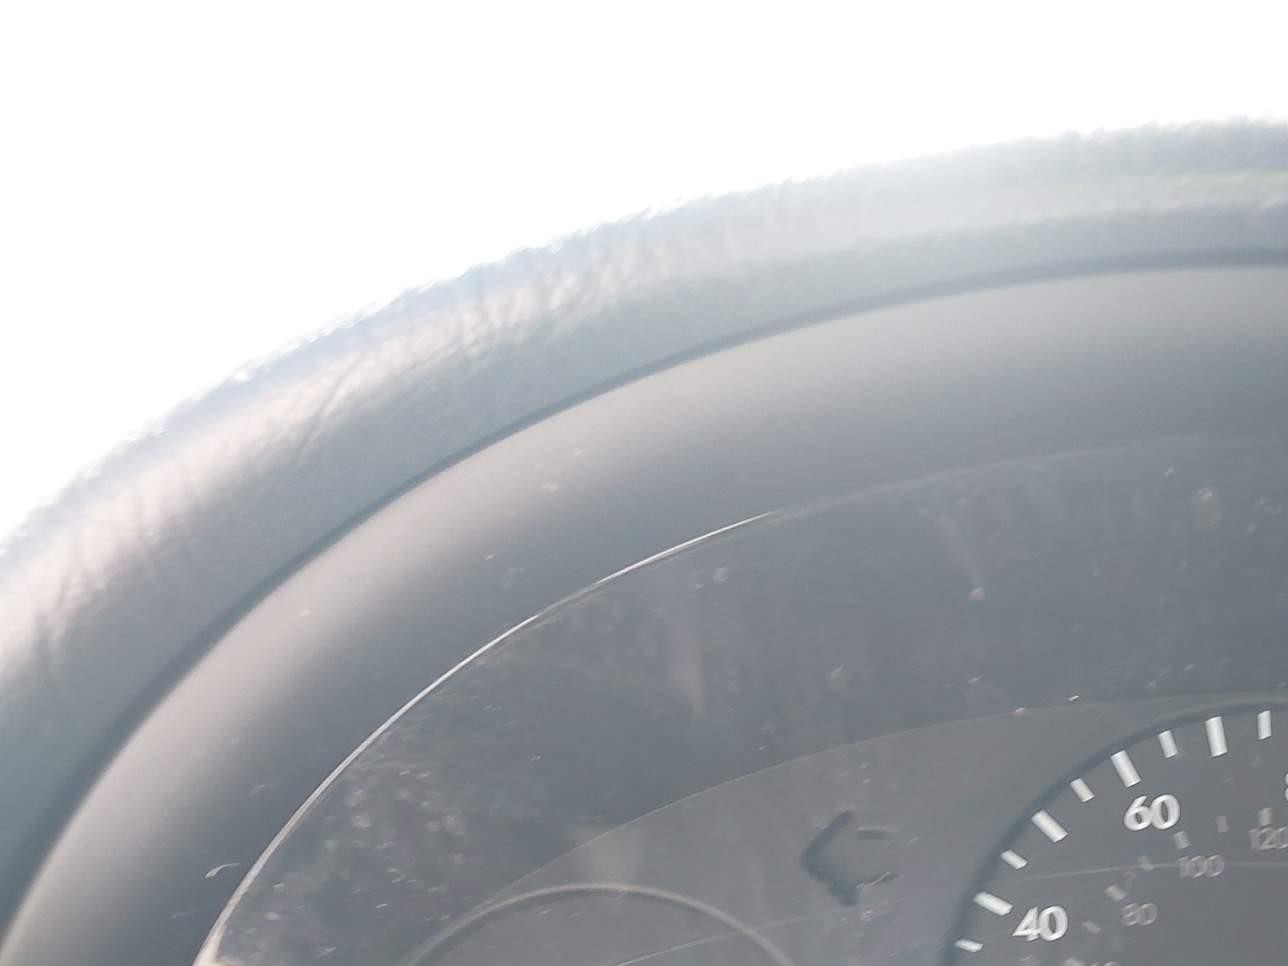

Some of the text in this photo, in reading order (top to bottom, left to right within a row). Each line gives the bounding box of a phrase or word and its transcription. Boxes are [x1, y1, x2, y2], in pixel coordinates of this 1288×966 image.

[1123, 794, 1181, 830] 60
[1178, 854, 1225, 879] 100
[1012, 906, 1069, 941] 40
[1121, 903, 1159, 927] 80
